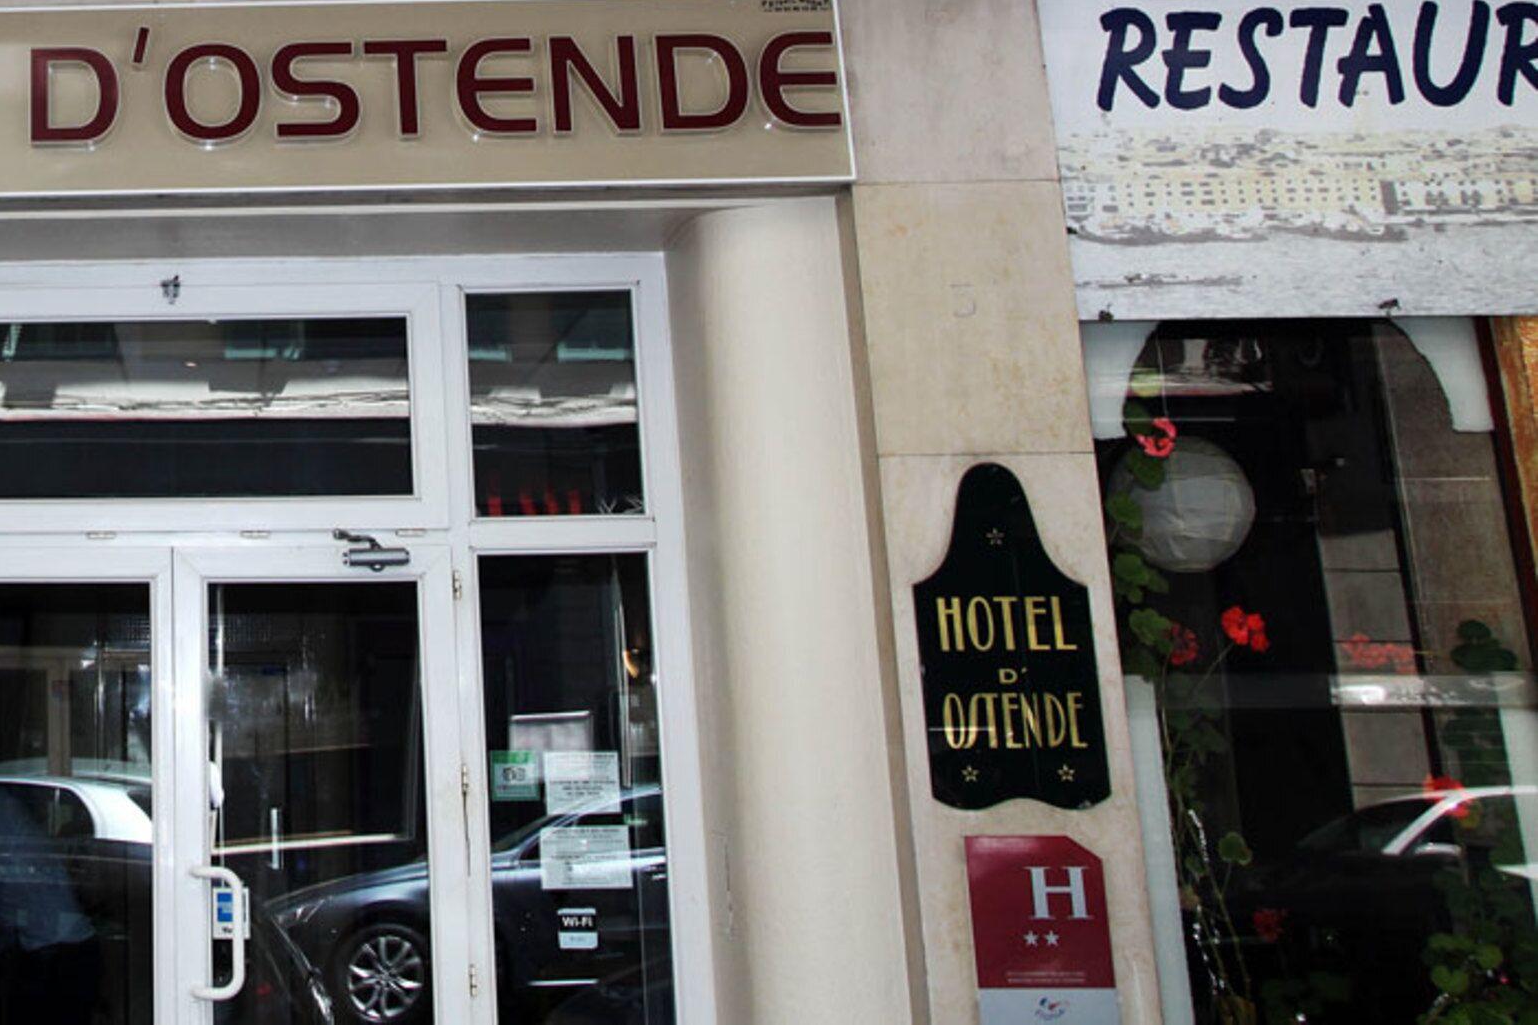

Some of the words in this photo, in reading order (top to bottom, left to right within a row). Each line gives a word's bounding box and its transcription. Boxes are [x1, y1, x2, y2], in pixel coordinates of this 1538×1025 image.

[30, 26, 842, 146] D'OSTENDE
[936, 595, 1078, 652] HOTEL
[998, 666, 1028, 685] D'
[943, 691, 1088, 749] OSTENDE
[1024, 865, 1094, 920] H
